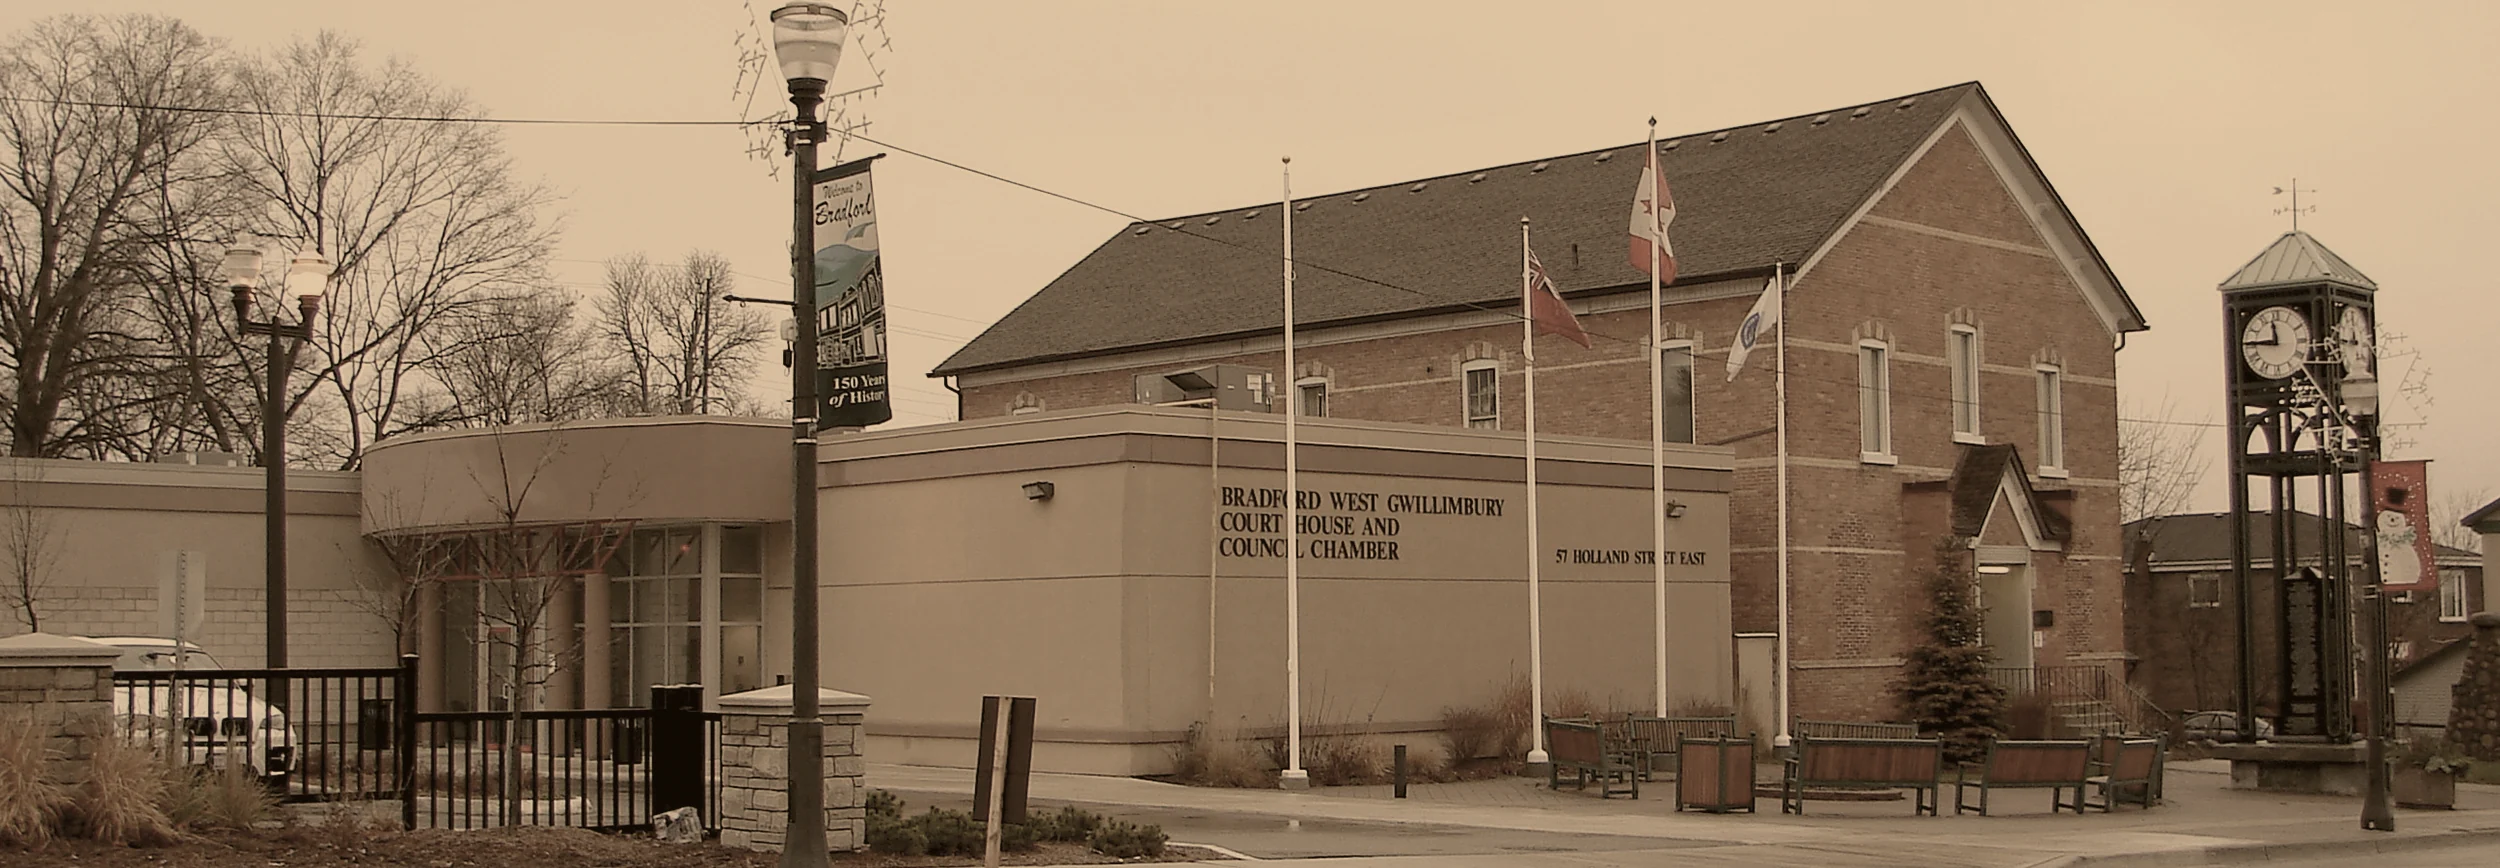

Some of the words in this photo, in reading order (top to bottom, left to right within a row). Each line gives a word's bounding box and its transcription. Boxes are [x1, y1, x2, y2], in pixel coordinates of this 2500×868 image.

[856, 180, 863, 191] to
[815, 193, 872, 228] Bradford
[833, 376, 858, 389] 150
[829, 393, 848, 408] of
[1329, 492, 1379, 512] WEST
[1387, 494, 1505, 517] GWILLIMBURY
[1220, 512, 1283, 533] COURT
[1295, 515, 1355, 536] HOUSE
[1362, 518, 1400, 536] AND
[1311, 540, 1400, 560] CHAMBER
[1555, 549, 1568, 563] 57
[1573, 549, 1629, 564] HOLLAND
[1634, 551, 1675, 565] STRET
[1680, 551, 1706, 565] EAST
